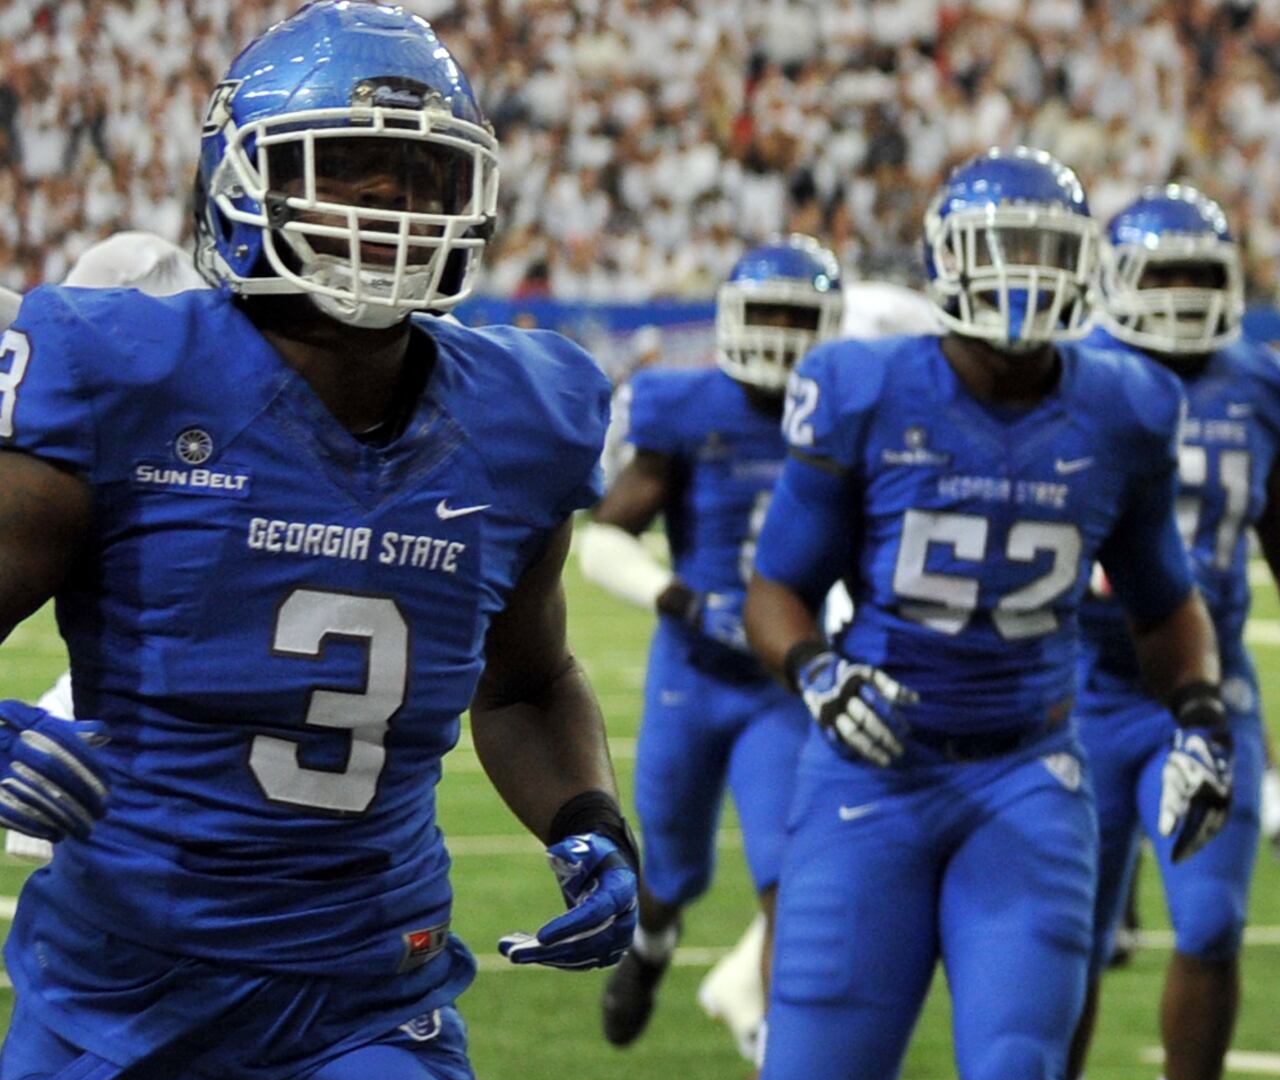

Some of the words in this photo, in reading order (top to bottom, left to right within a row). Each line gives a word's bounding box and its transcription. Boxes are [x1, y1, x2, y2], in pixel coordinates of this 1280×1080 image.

[247, 517, 373, 561] GEORGIA
[378, 531, 466, 573] STATE
[892, 508, 1083, 641] 52
[247, 586, 410, 814] 3
